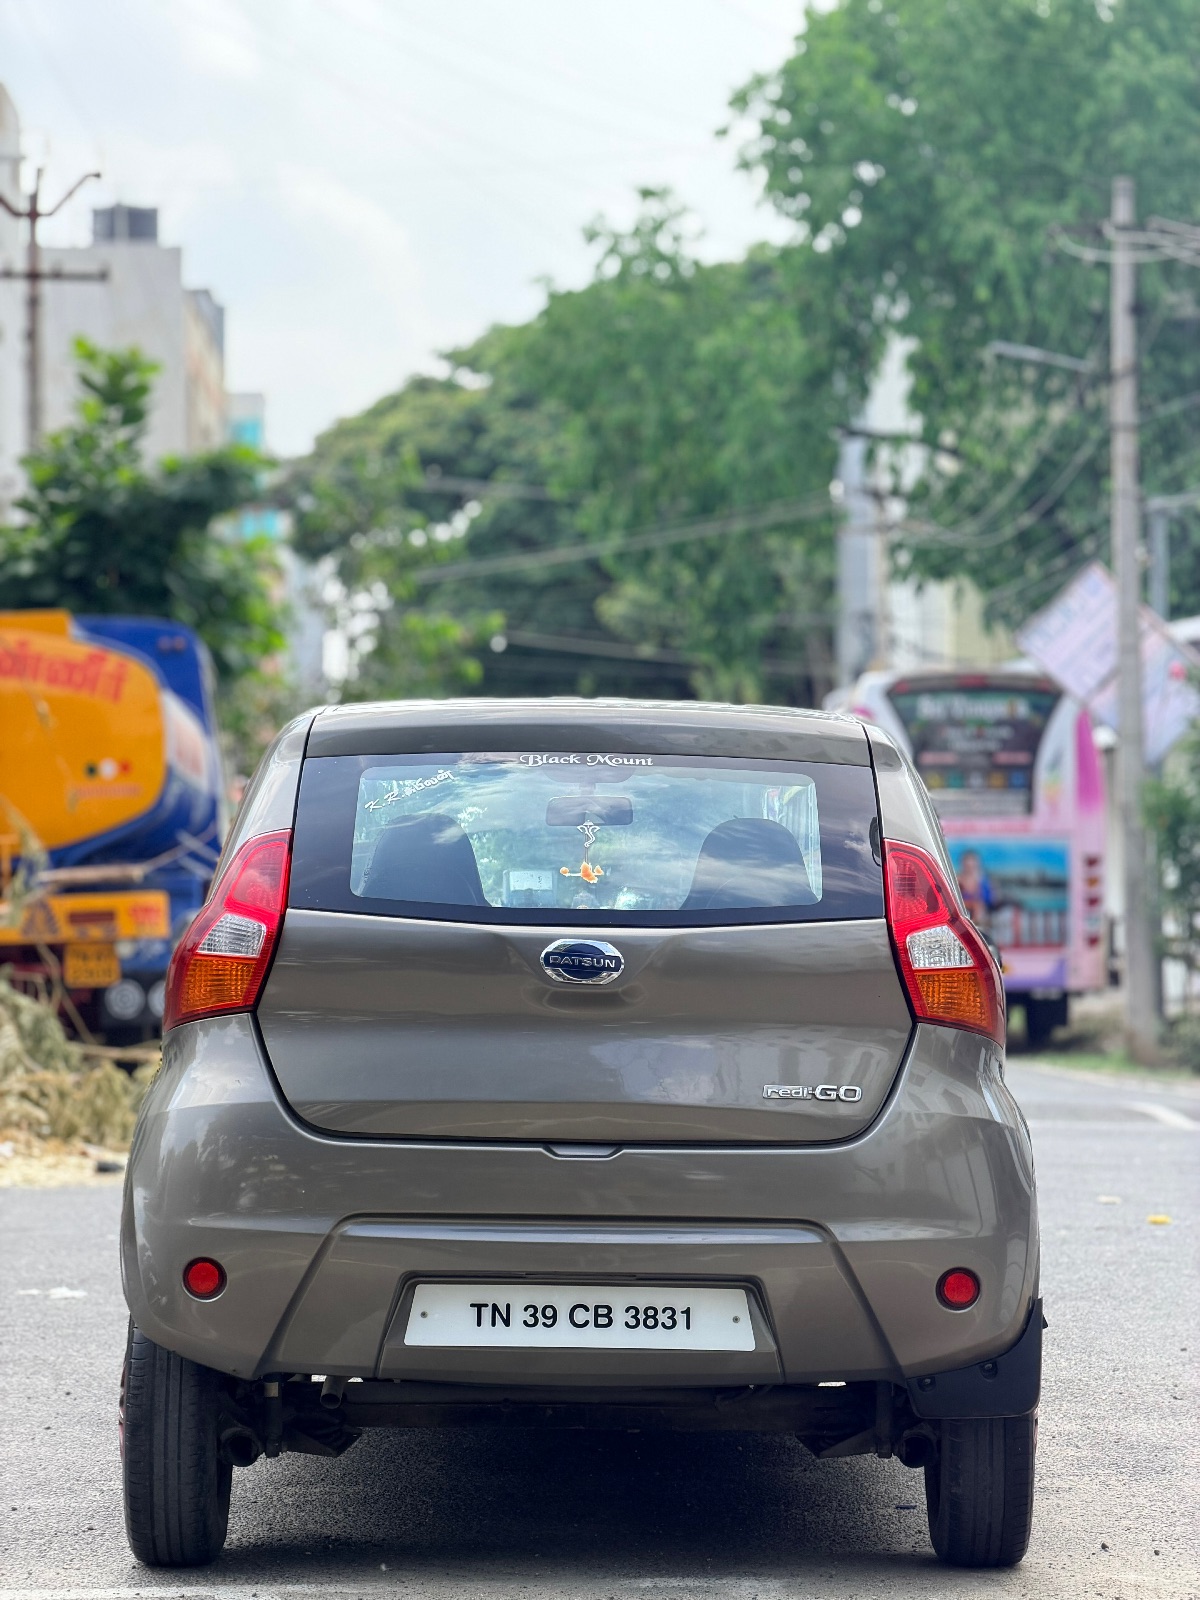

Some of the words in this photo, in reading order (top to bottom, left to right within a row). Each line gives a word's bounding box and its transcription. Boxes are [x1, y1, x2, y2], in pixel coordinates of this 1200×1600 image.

[519, 753, 581, 767] Black
[586, 754, 654, 767] Mount
[549, 954, 617, 969] DATSUN
[470, 1303, 512, 1328] TN
[522, 1304, 559, 1329] 39
[568, 1304, 614, 1329] CB
[624, 1306, 692, 1331] 3831
